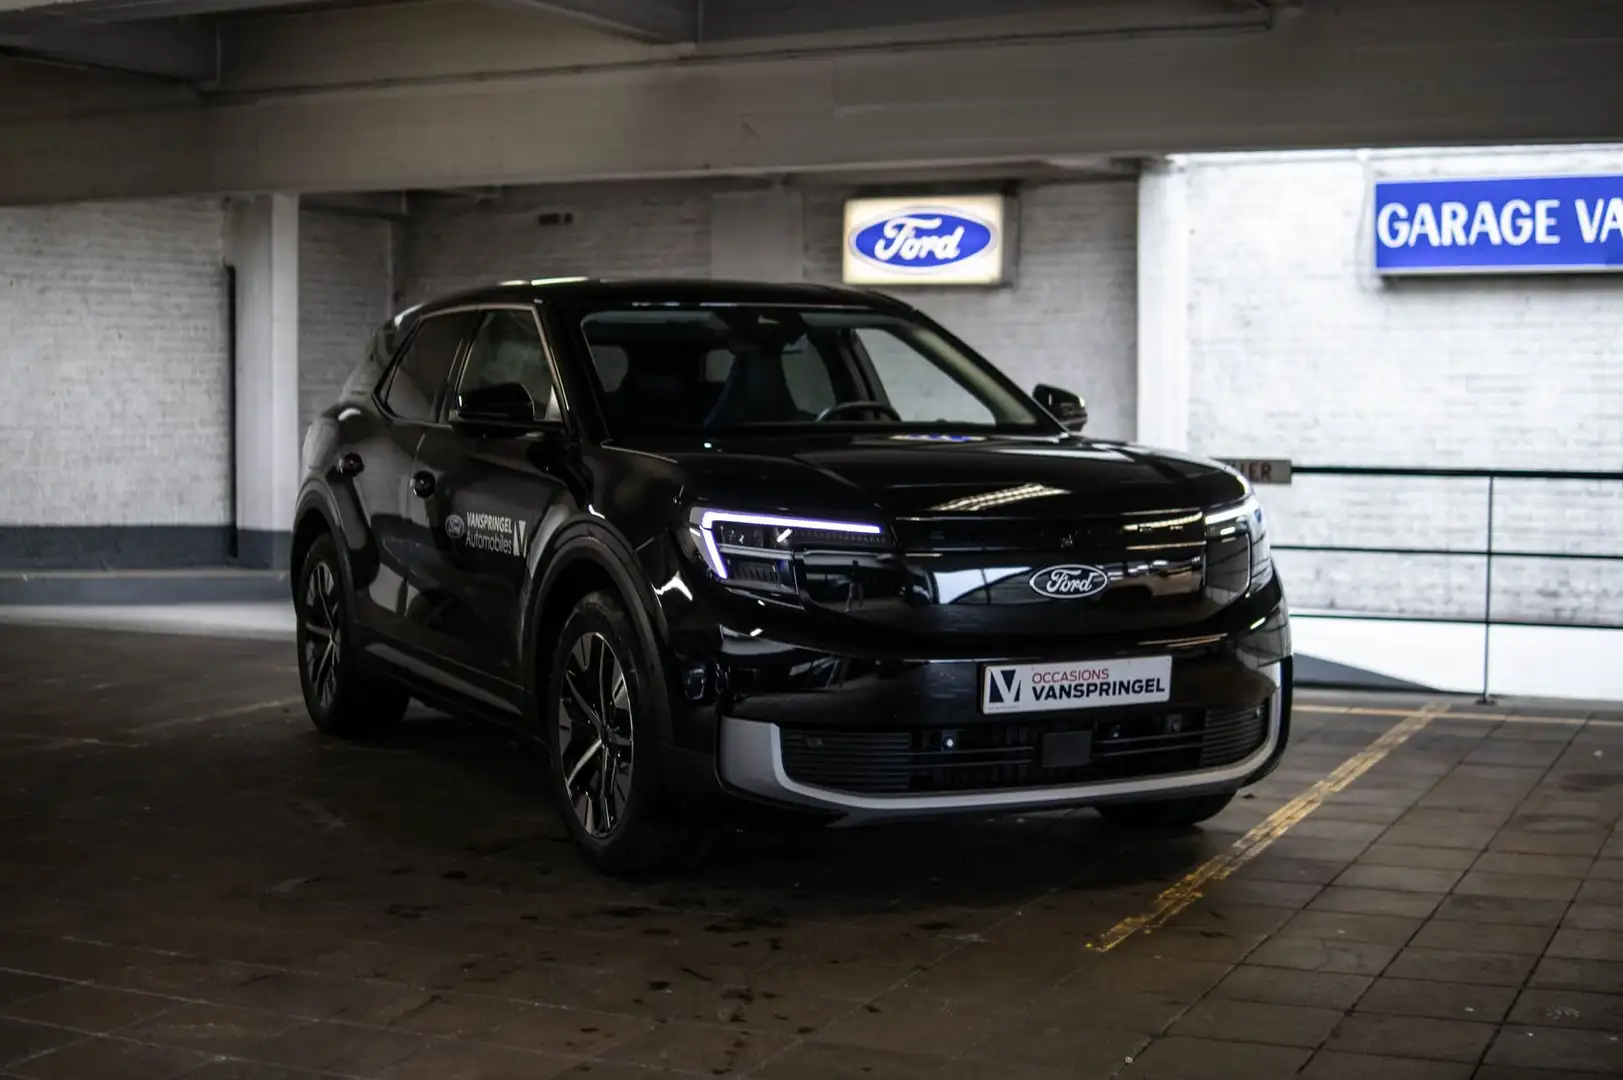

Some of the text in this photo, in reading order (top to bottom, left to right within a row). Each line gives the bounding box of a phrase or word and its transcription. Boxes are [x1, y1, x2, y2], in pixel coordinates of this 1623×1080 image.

[1377, 199, 1561, 248] GARAGE
[874, 217, 965, 260] Ford
[466, 511, 512, 534] VANSPRINGEL
[465, 529, 512, 555] Automobiles
[1046, 569, 1093, 592] Ford
[1032, 668, 1109, 684] OCCASIONS
[1032, 678, 1165, 701] VANSPRINGEL
